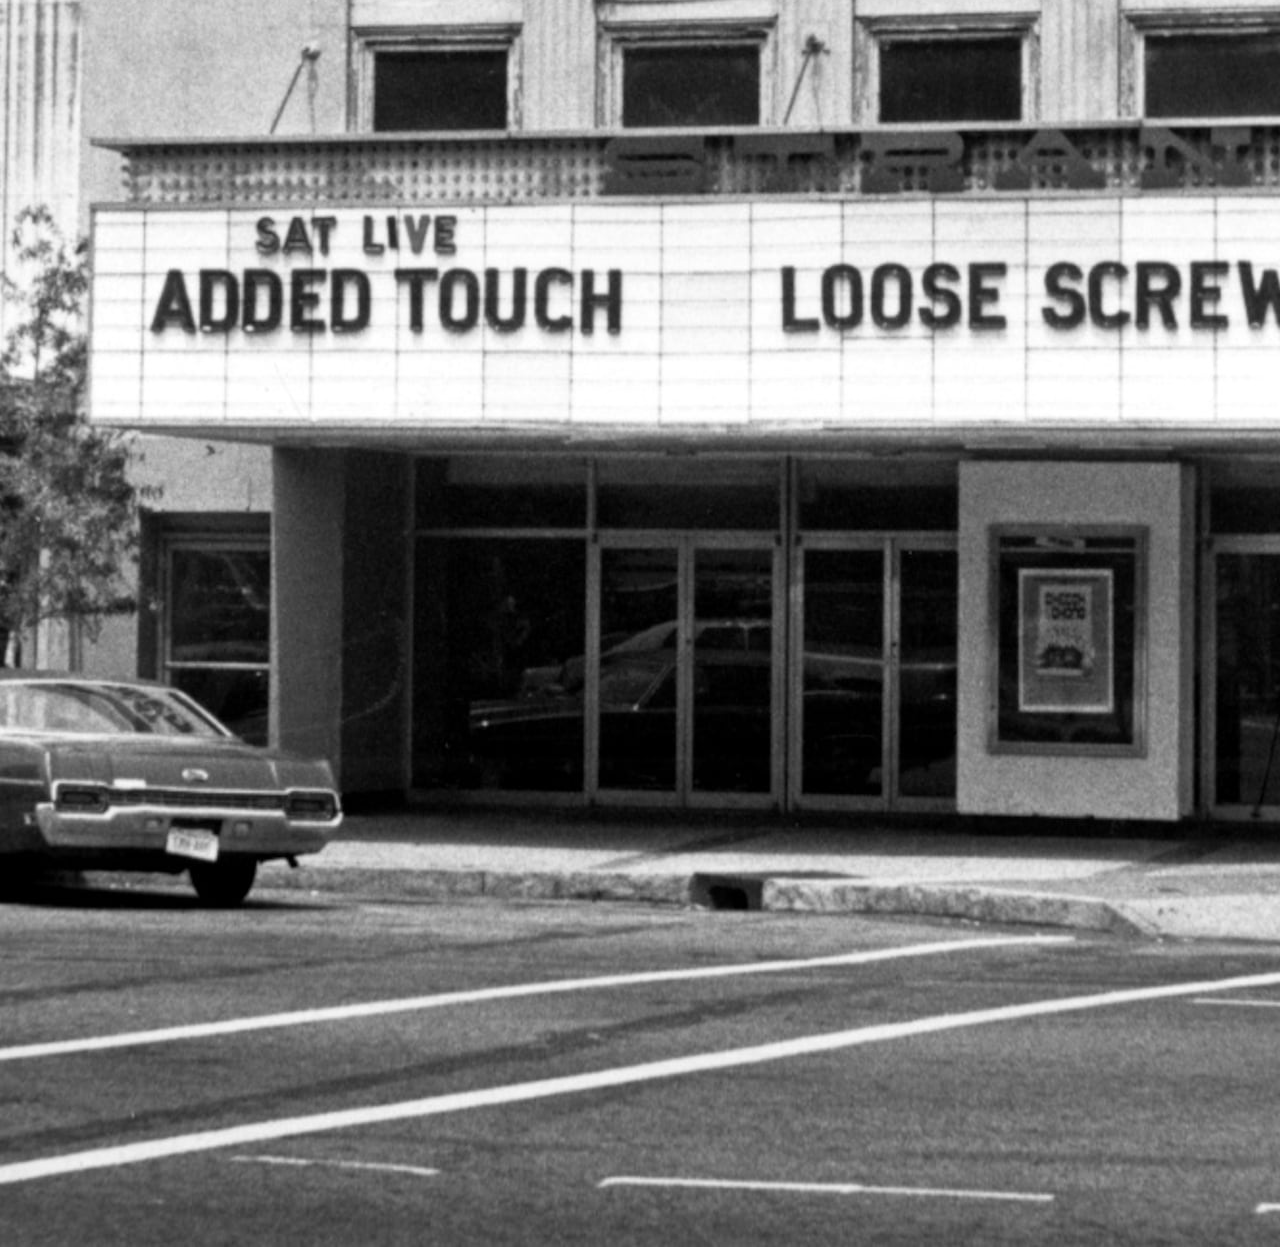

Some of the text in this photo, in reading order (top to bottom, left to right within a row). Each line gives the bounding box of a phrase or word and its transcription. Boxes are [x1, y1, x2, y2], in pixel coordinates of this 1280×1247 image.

[255, 214, 458, 256] SAT LIVE
[150, 265, 624, 334] ADDED TOUCH
[780, 261, 1008, 332] LOOSE
